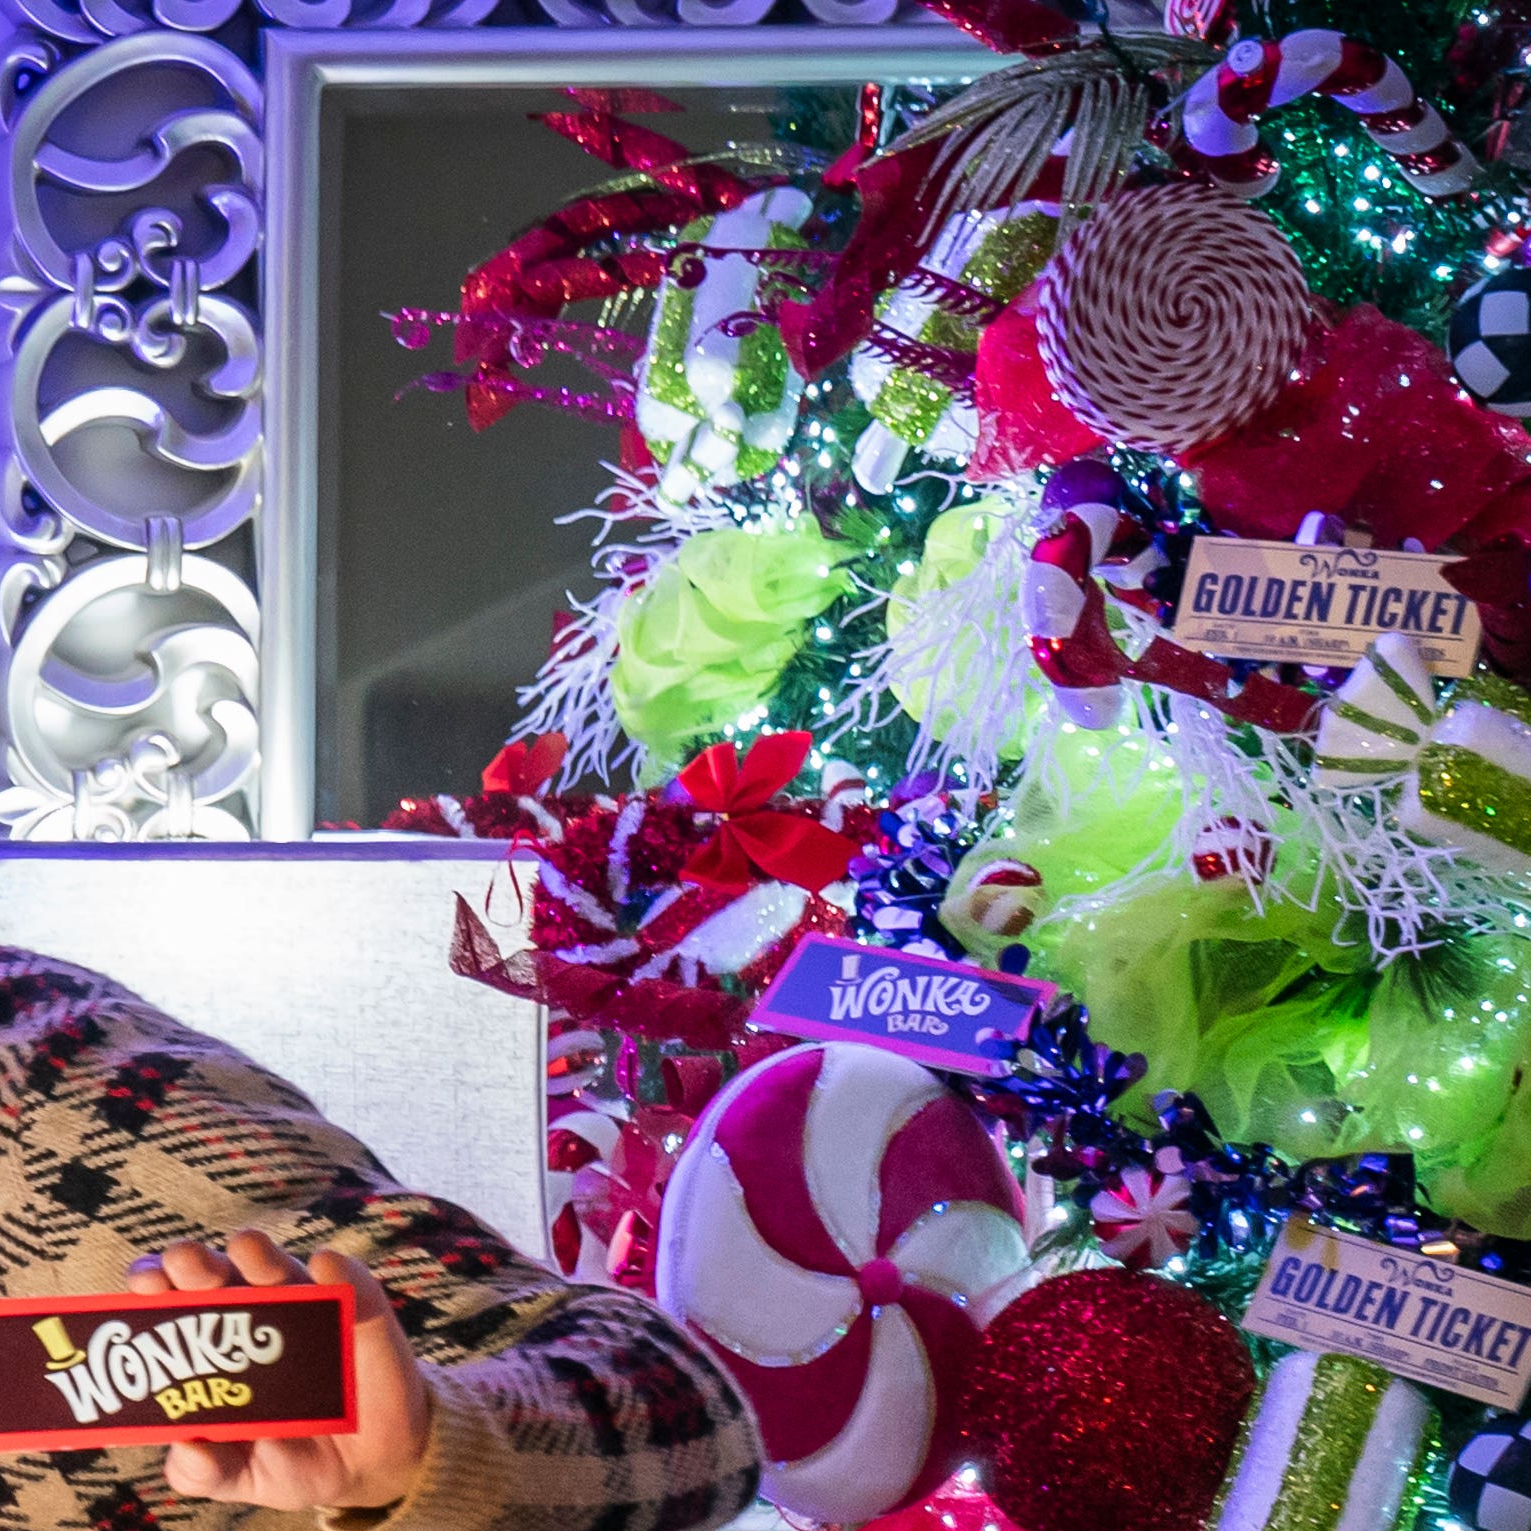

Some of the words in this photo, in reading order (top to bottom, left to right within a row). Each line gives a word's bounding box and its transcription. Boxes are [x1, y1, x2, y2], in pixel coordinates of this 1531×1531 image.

[1192, 572, 1338, 623] GOLDEN
[1344, 583, 1472, 635] TICKET
[829, 967, 991, 1020] WONKA
[887, 1013, 949, 1036] BAR
[1269, 1256, 1412, 1330] GOLDEN
[1409, 1296, 1531, 1368] TICKET
[44, 1312, 284, 1423] WONKA
[154, 1377, 253, 1420] BAR
